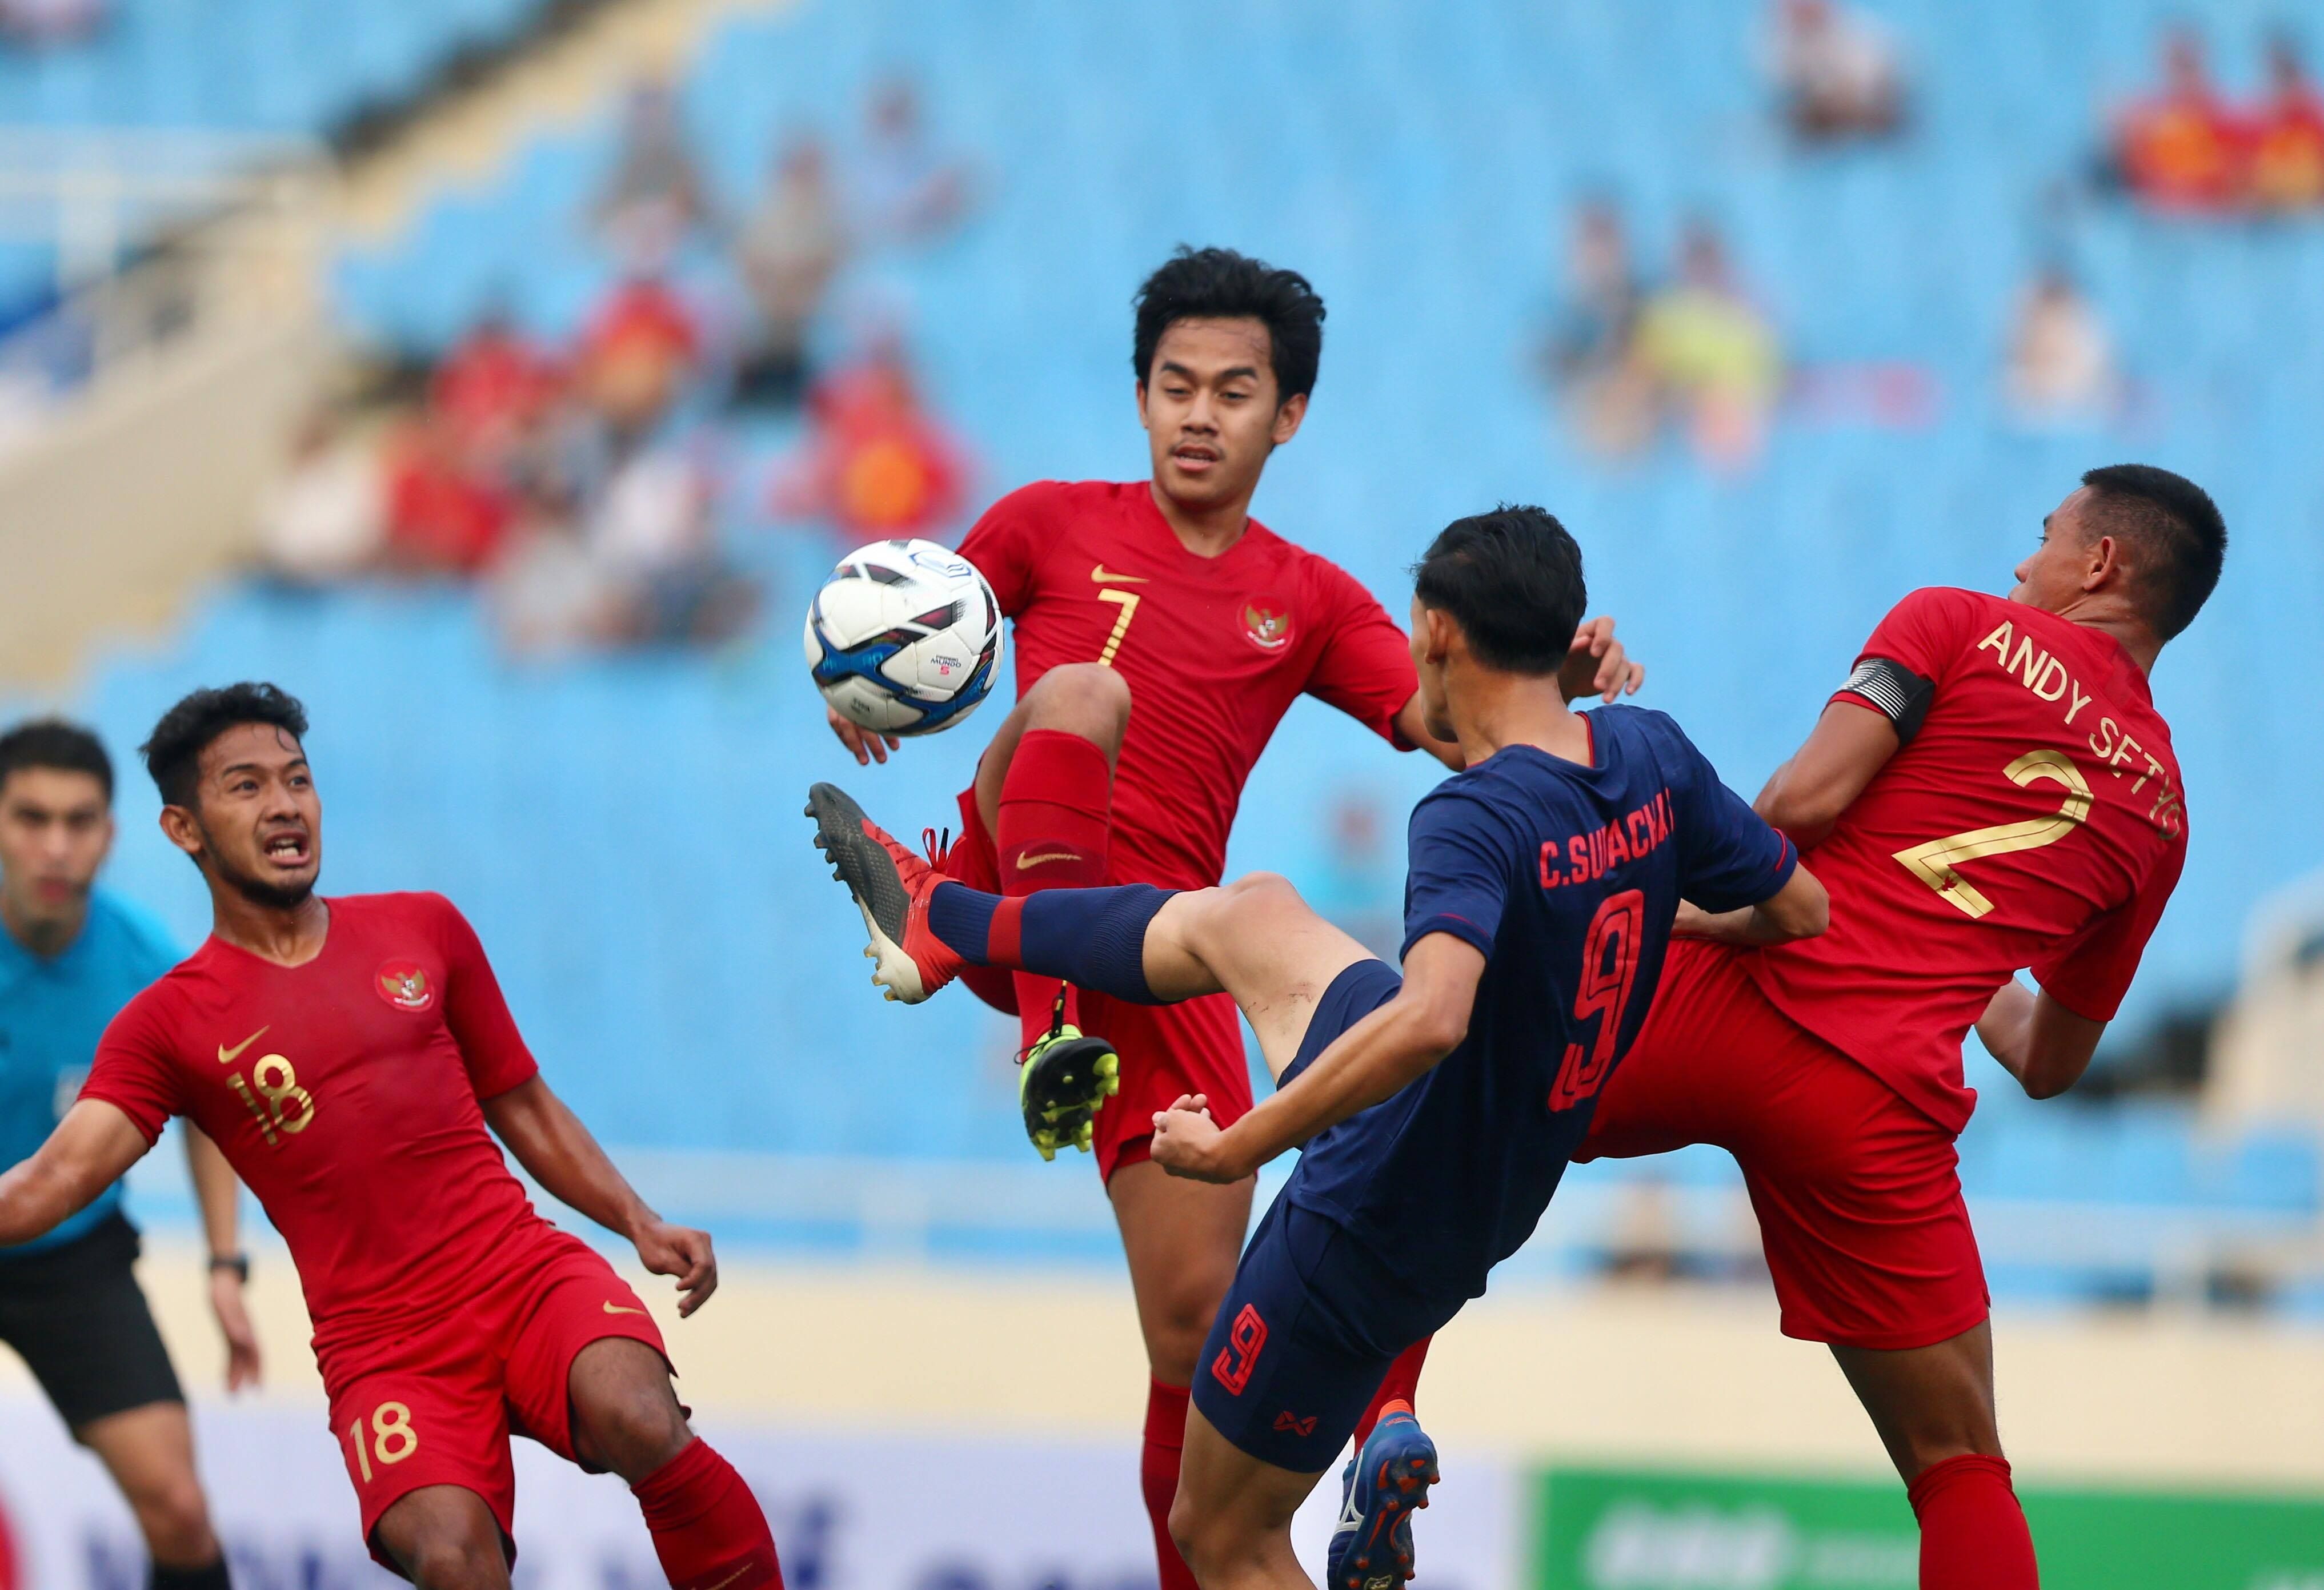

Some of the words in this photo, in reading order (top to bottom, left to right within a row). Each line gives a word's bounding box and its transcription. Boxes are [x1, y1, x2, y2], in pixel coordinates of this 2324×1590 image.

[930, 657, 961, 668] MUNDO
[1097, 588, 1140, 666] 7
[1977, 620, 2093, 724] ANDY
[1892, 749, 2094, 919] 2
[1548, 889, 1644, 1113] 9
[226, 1054, 315, 1149] 18
[1212, 1303, 1268, 1396] 9
[350, 1402, 418, 1484] 18
